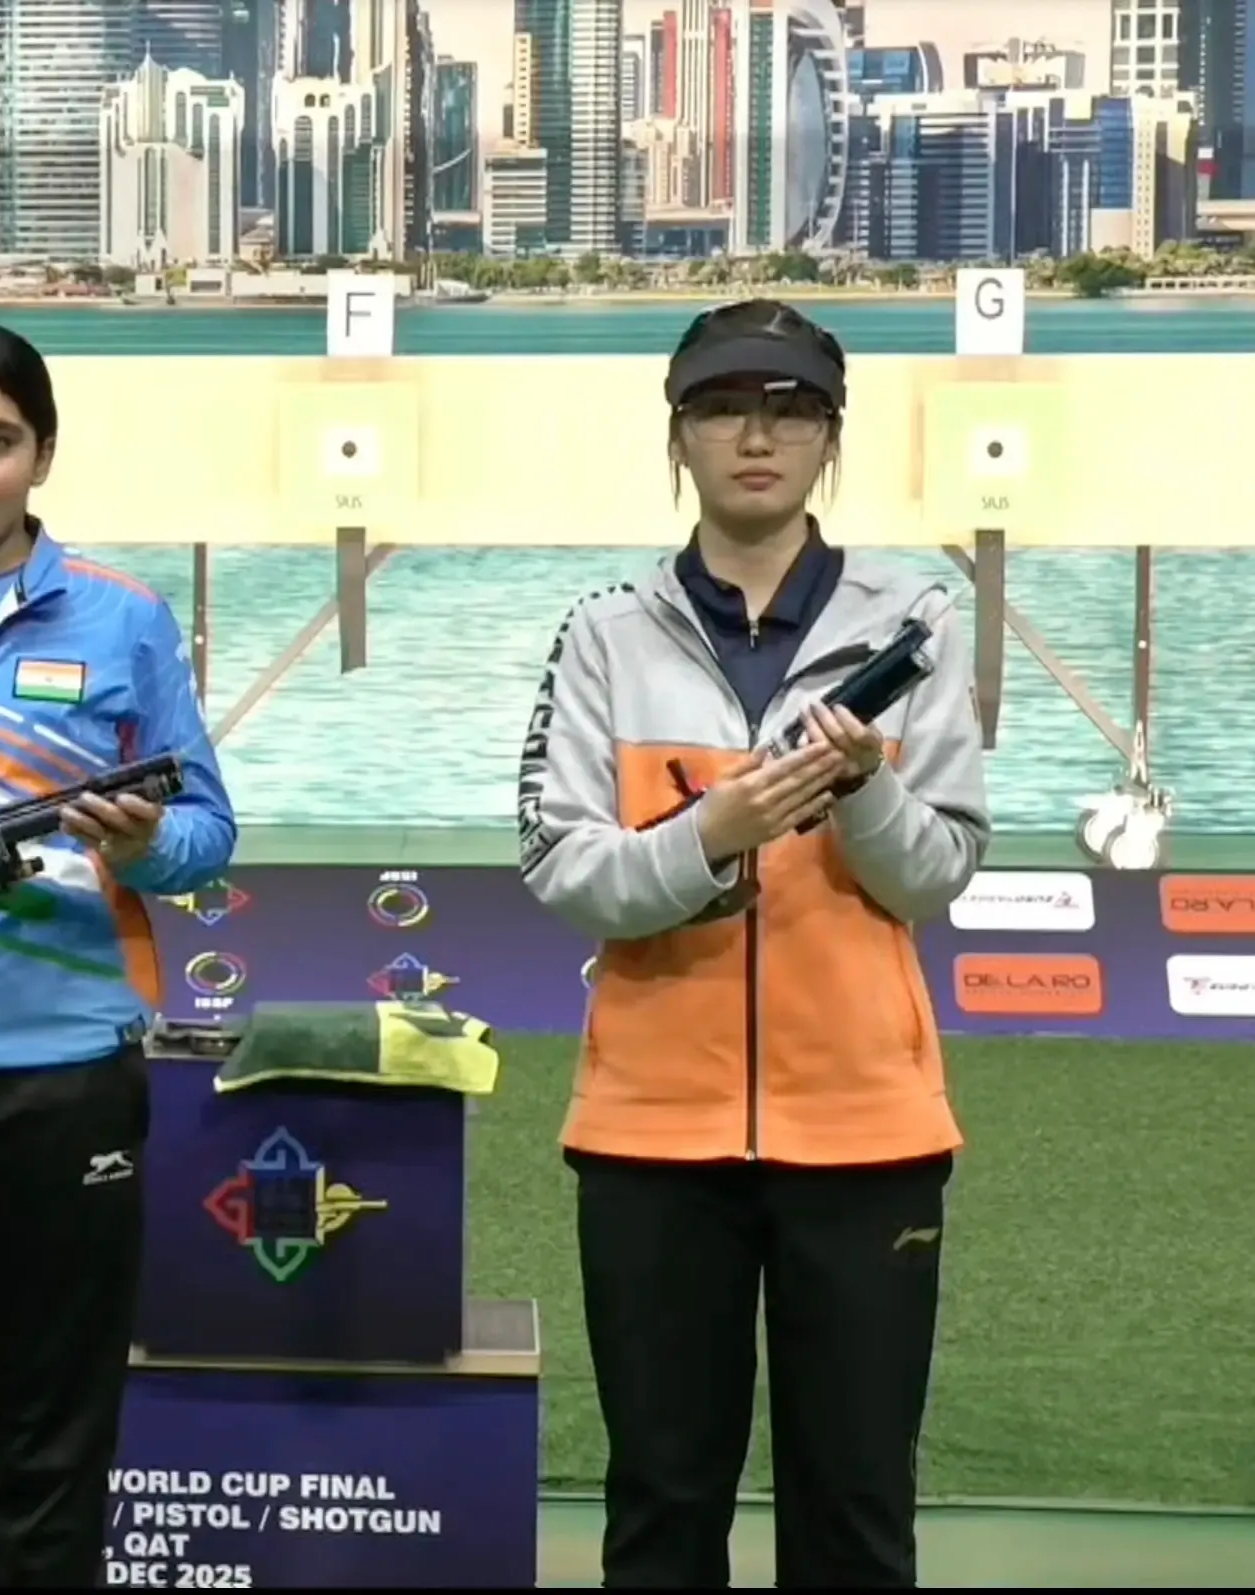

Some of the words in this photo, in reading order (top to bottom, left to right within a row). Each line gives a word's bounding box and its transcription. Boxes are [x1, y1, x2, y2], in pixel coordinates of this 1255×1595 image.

[974, 277, 1005, 320] G
[345, 292, 376, 337] F
[221, 1471, 291, 1498] CUP
[300, 1473, 396, 1500] FINAL
[133, 1502, 251, 1529] PISTOL
[278, 1504, 441, 1534] SHOTGUN
[124, 1531, 190, 1558] QAT
[106, 1561, 168, 1588] DEC
[174, 1563, 253, 1589] 2025
